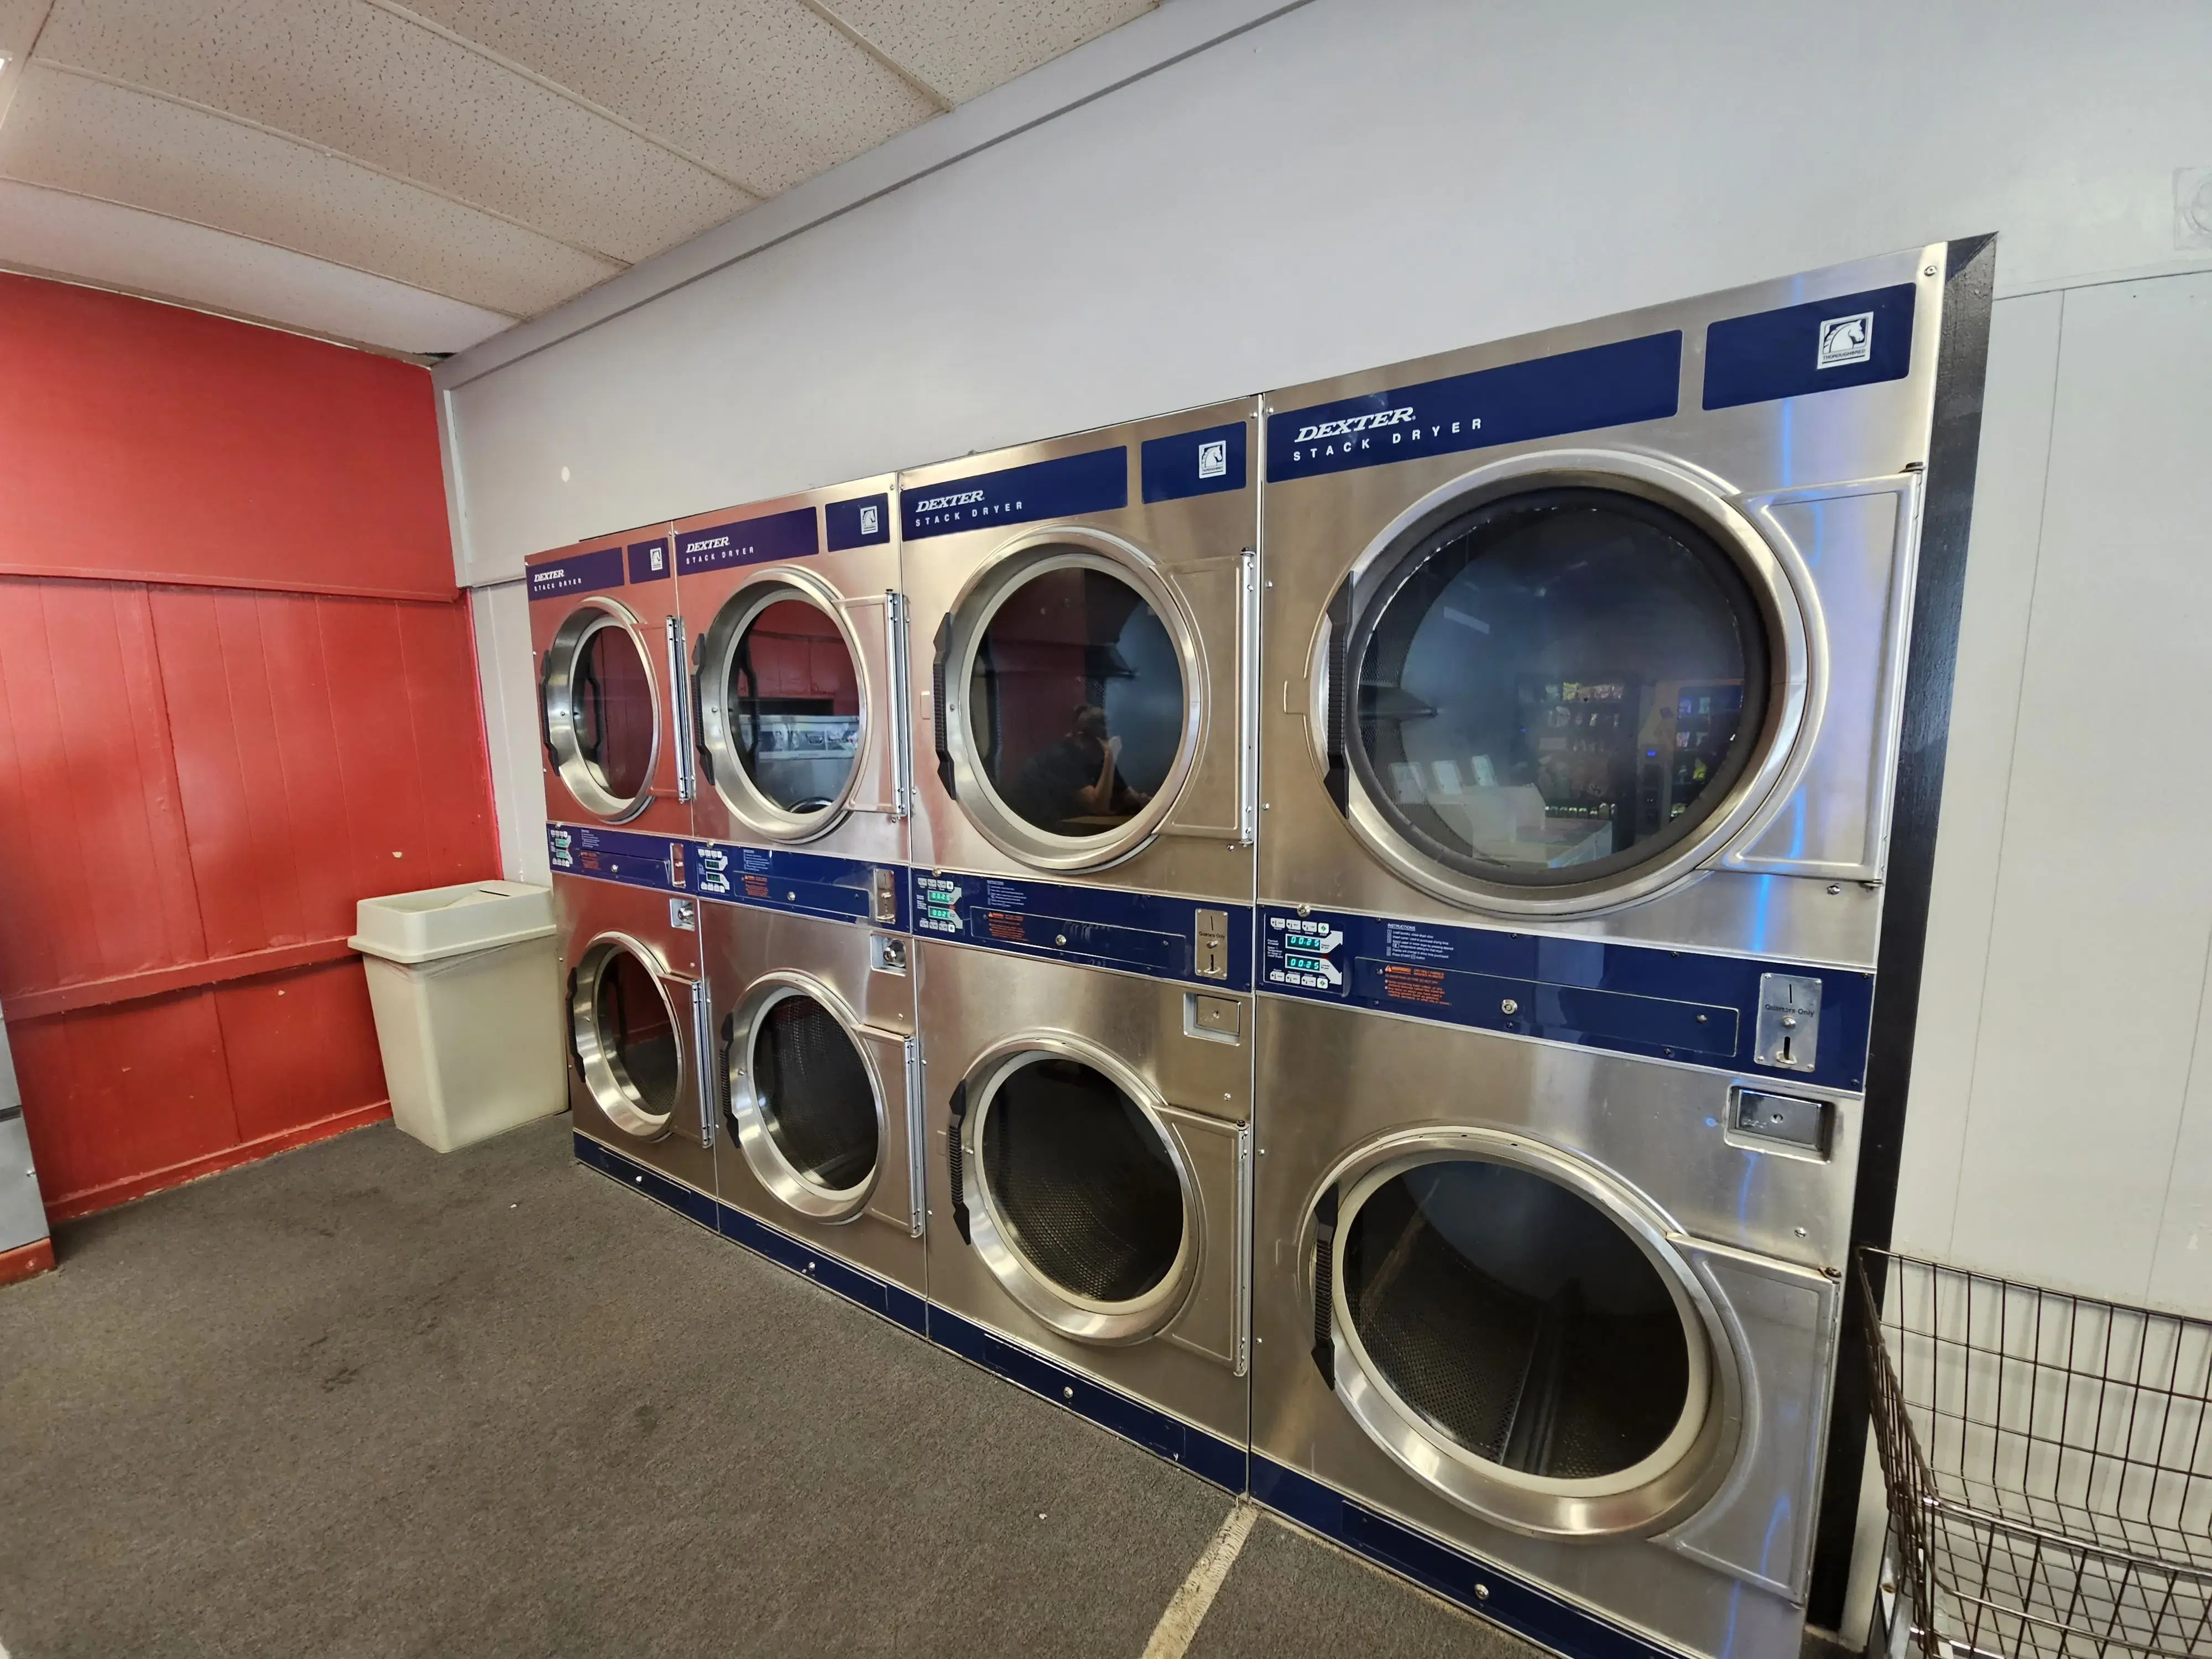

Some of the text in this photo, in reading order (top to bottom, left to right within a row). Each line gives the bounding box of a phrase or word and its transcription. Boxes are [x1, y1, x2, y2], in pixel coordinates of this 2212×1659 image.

[1294, 406, 1413, 443] DEXTER
[1293, 418, 1481, 461] STACK DRYER
[915, 490, 983, 513] DEXTER
[915, 502, 1022, 527] STACK DRYER
[686, 536, 729, 553] DEXTER
[686, 546, 754, 565] STACK DRYER
[534, 569, 564, 582] DEXTER
[1798, 1008, 1814, 1018] Only
